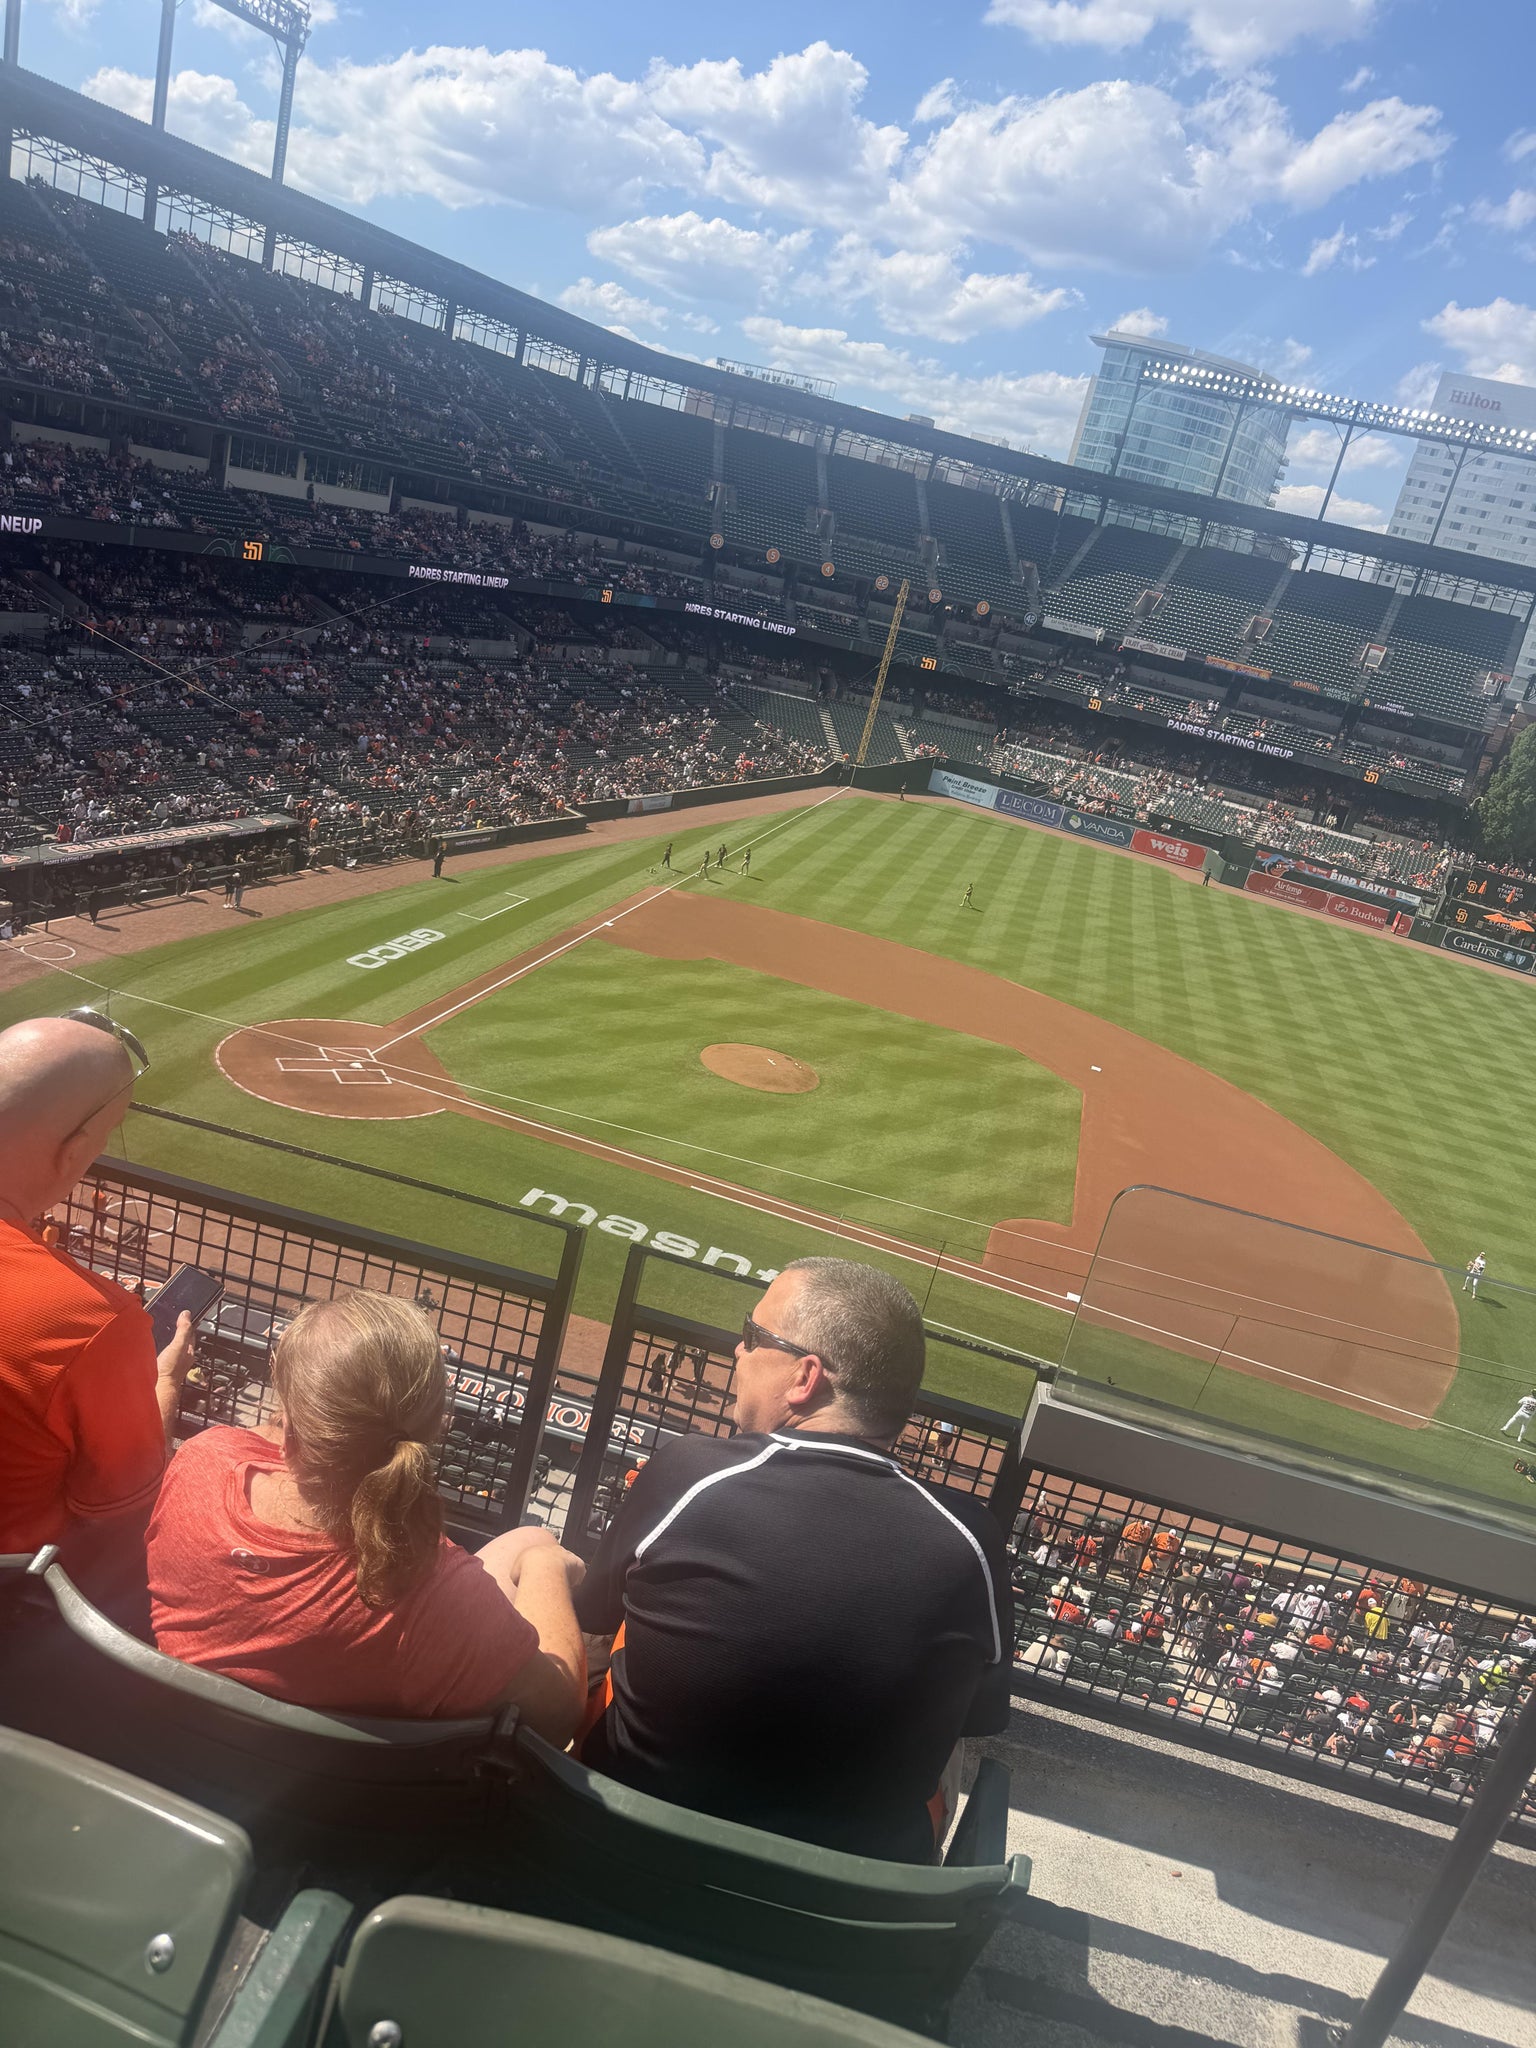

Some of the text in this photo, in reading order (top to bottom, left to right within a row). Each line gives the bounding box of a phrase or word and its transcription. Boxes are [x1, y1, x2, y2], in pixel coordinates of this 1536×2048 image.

[1449, 389, 1502, 411] Hilton
[409, 565, 509, 589] PADRES STARTING LINEUP
[684, 603, 796, 636] PADRES STARTING LINEUP
[1166, 720, 1294, 759] PADRES STARTING LINEUP
[962, 781, 987, 794] Breeze
[1001, 794, 1057, 819] LECOM
[1083, 820, 1125, 840] VANDA
[1150, 838, 1190, 858] weis
[1330, 871, 1389, 895] BIRD BATH
[346, 928, 447, 969] GEICO
[1453, 935, 1502, 958] CareFirst
